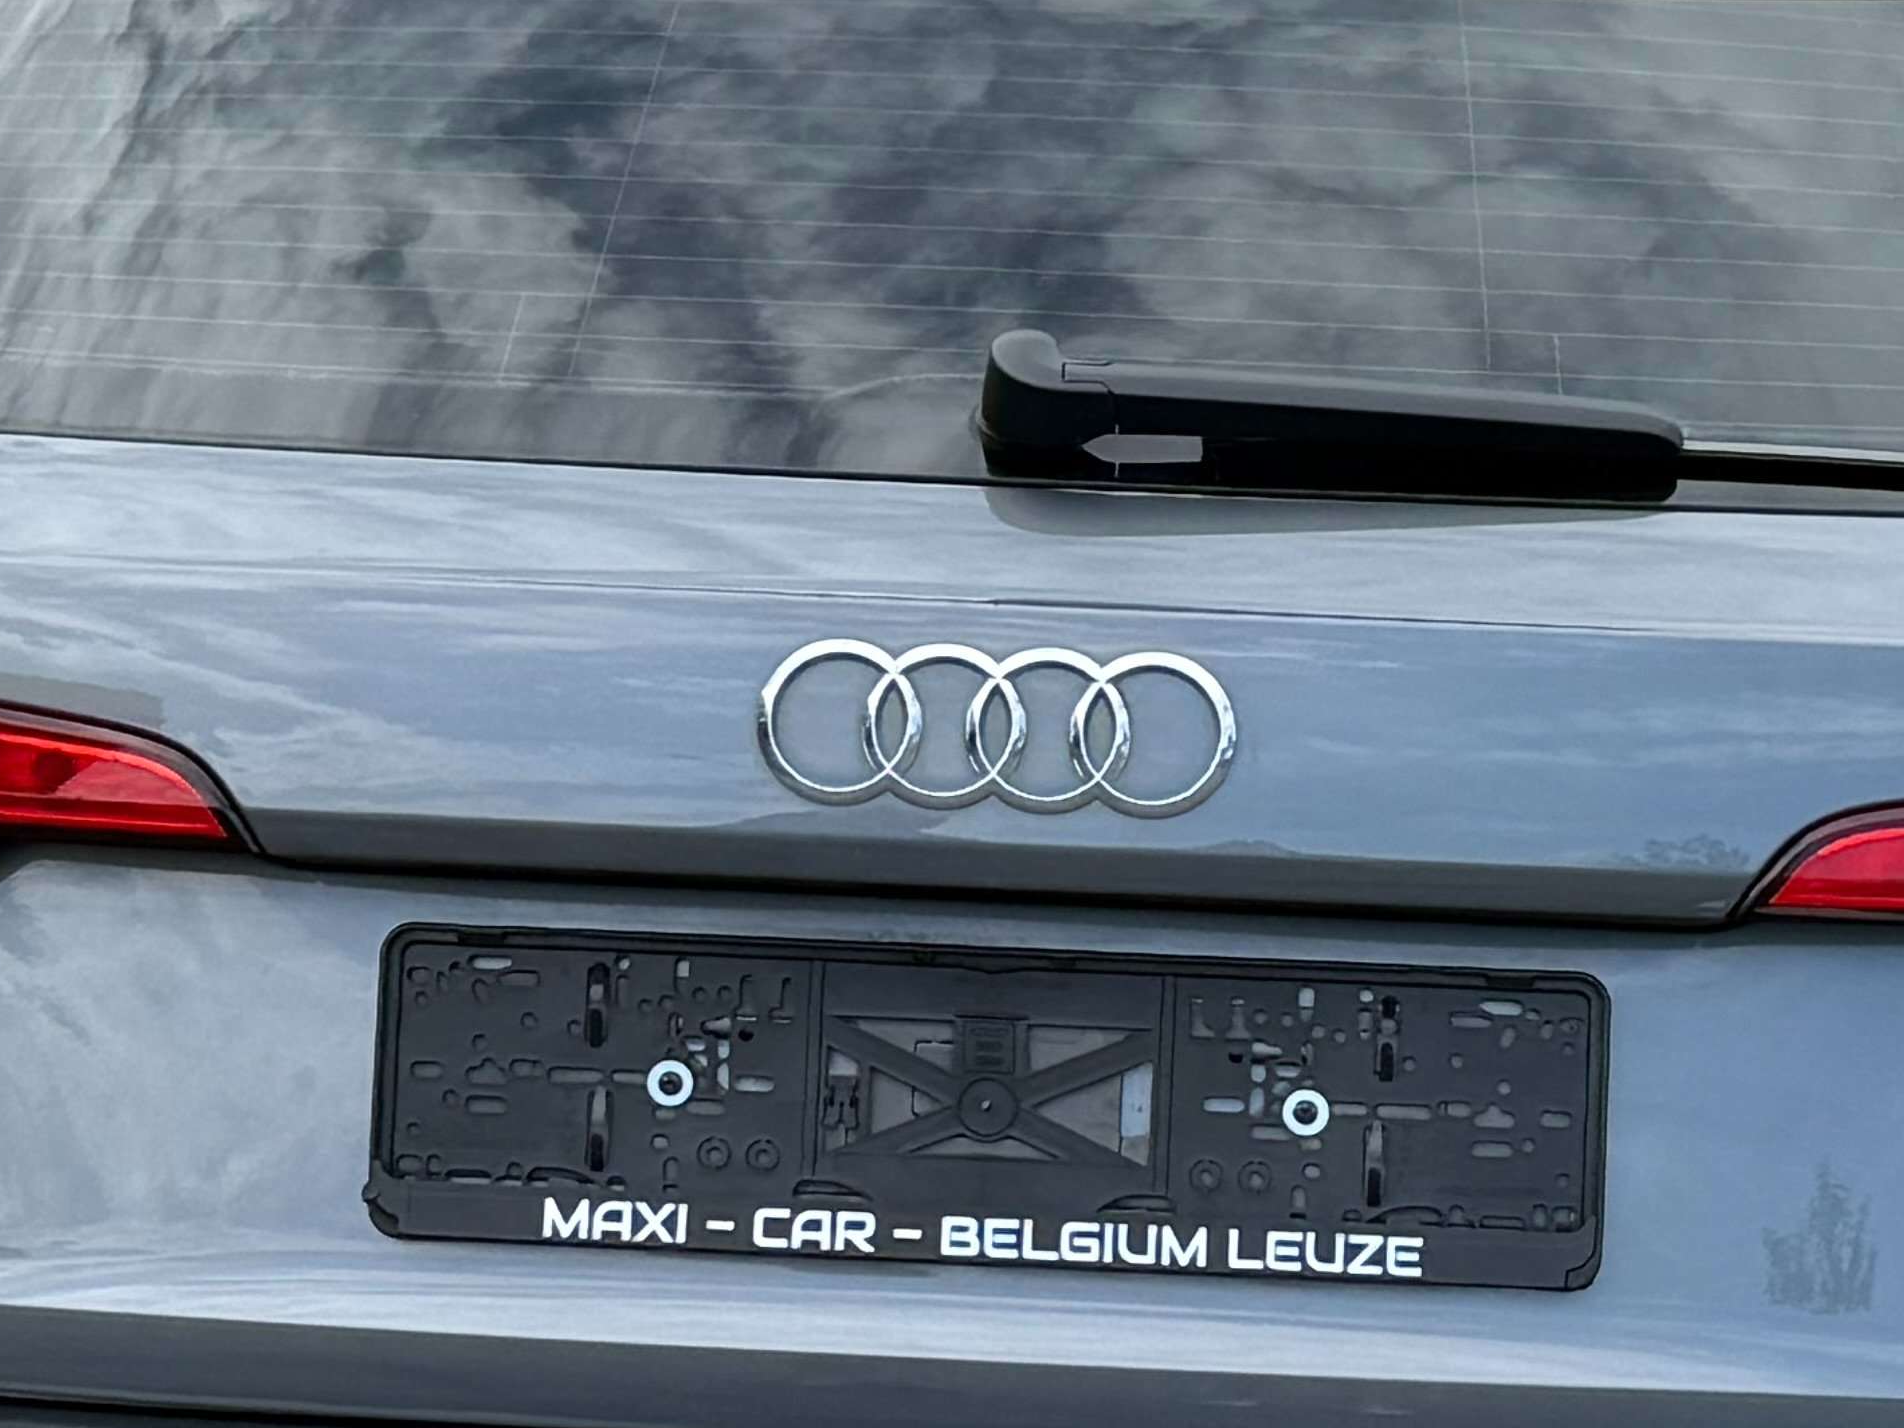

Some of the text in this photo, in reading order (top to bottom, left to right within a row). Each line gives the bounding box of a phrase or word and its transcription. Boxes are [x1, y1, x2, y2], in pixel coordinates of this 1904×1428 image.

[542, 1197, 687, 1243] MAXI
[752, 1208, 875, 1253] CAR
[939, 1215, 1208, 1269] BELGIUM
[1226, 1229, 1424, 1278] LEUZE
